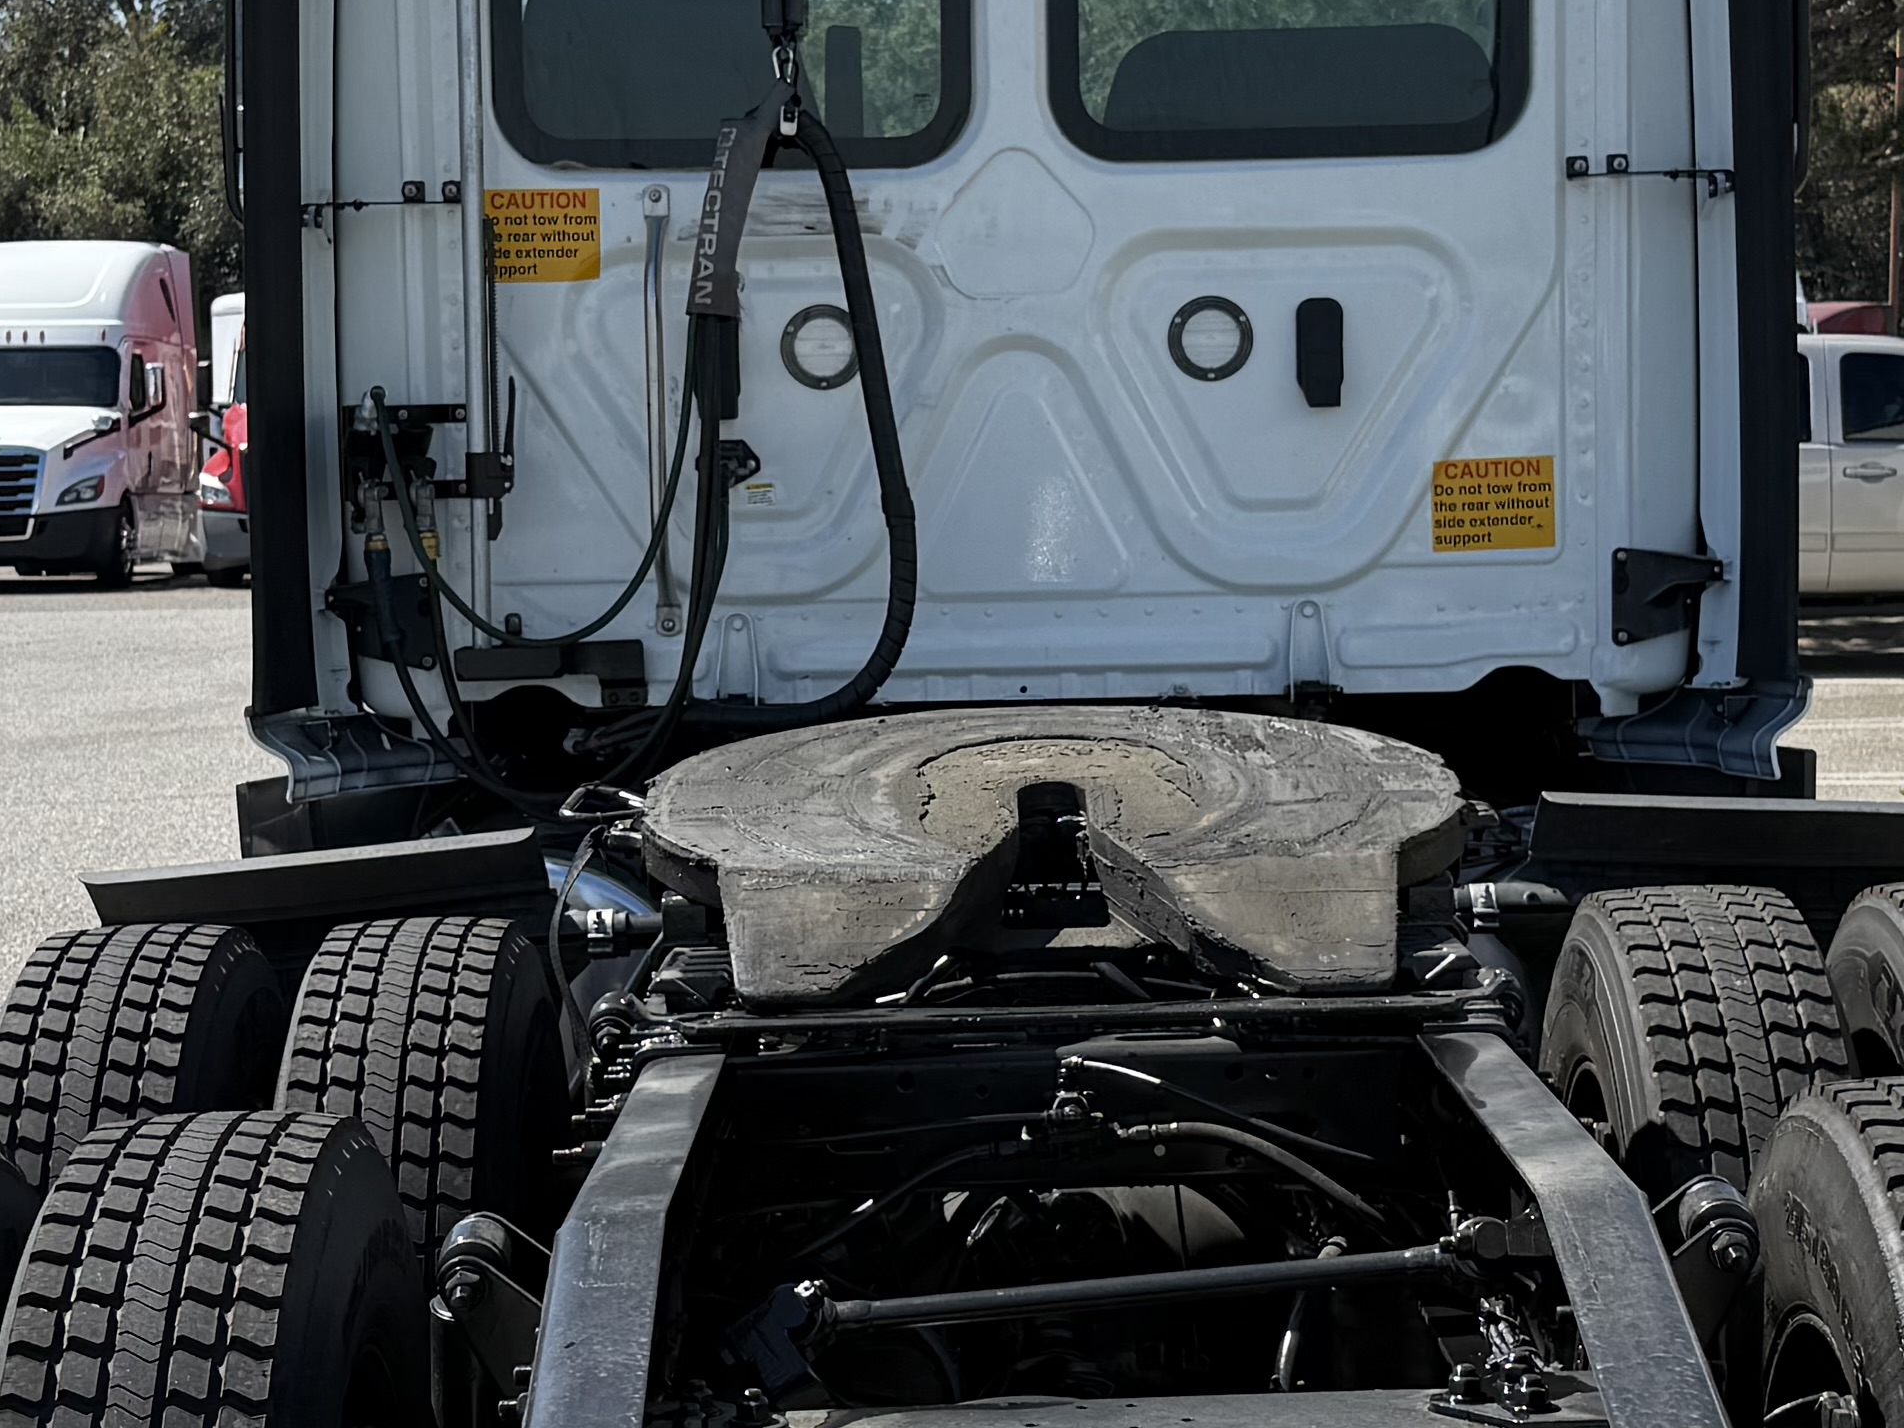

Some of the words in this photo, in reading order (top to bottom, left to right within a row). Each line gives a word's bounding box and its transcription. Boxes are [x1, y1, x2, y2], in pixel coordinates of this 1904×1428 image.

[491, 191, 587, 210] CAUTION
[504, 213, 528, 226] not
[532, 213, 559, 226] tow
[563, 212, 597, 226] from
[507, 232, 537, 243] rear
[540, 229, 596, 242] without
[515, 245, 580, 260] extender
[493, 263, 538, 279] pport
[1444, 459, 1541, 480] CAUTION
[1434, 483, 1454, 497] Do
[1458, 482, 1483, 495] not
[1487, 482, 1513, 495] tow
[1517, 480, 1552, 493] from
[1434, 499, 1457, 513] the
[1461, 501, 1490, 512] rear
[1494, 496, 1550, 510] without
[1434, 515, 1465, 529] side
[1469, 514, 1534, 528] extender
[1434, 531, 1492, 547] support
